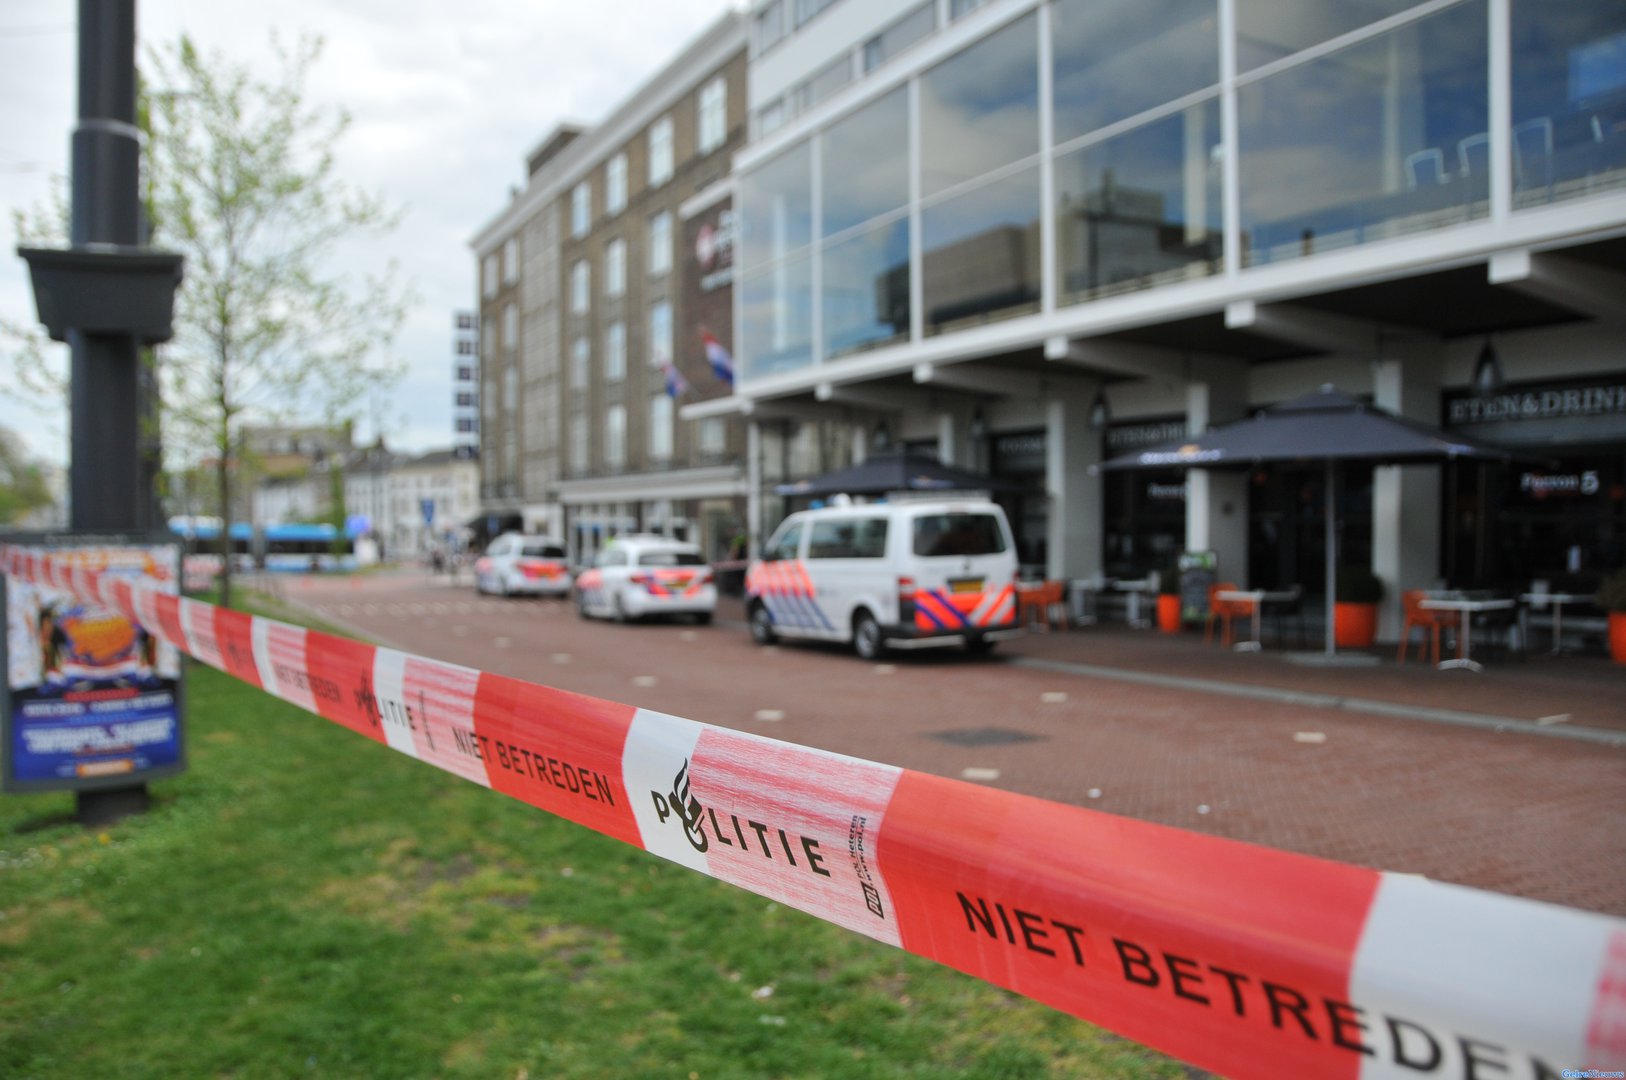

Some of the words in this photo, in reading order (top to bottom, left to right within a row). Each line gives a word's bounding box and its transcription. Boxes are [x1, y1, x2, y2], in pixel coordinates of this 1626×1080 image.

[452, 727, 493, 763] NIET
[495, 740, 615, 807] BETREDEN
[650, 757, 831, 878] POLITIE
[848, 814, 858, 859] Heteren
[955, 890, 1086, 968] NIET
